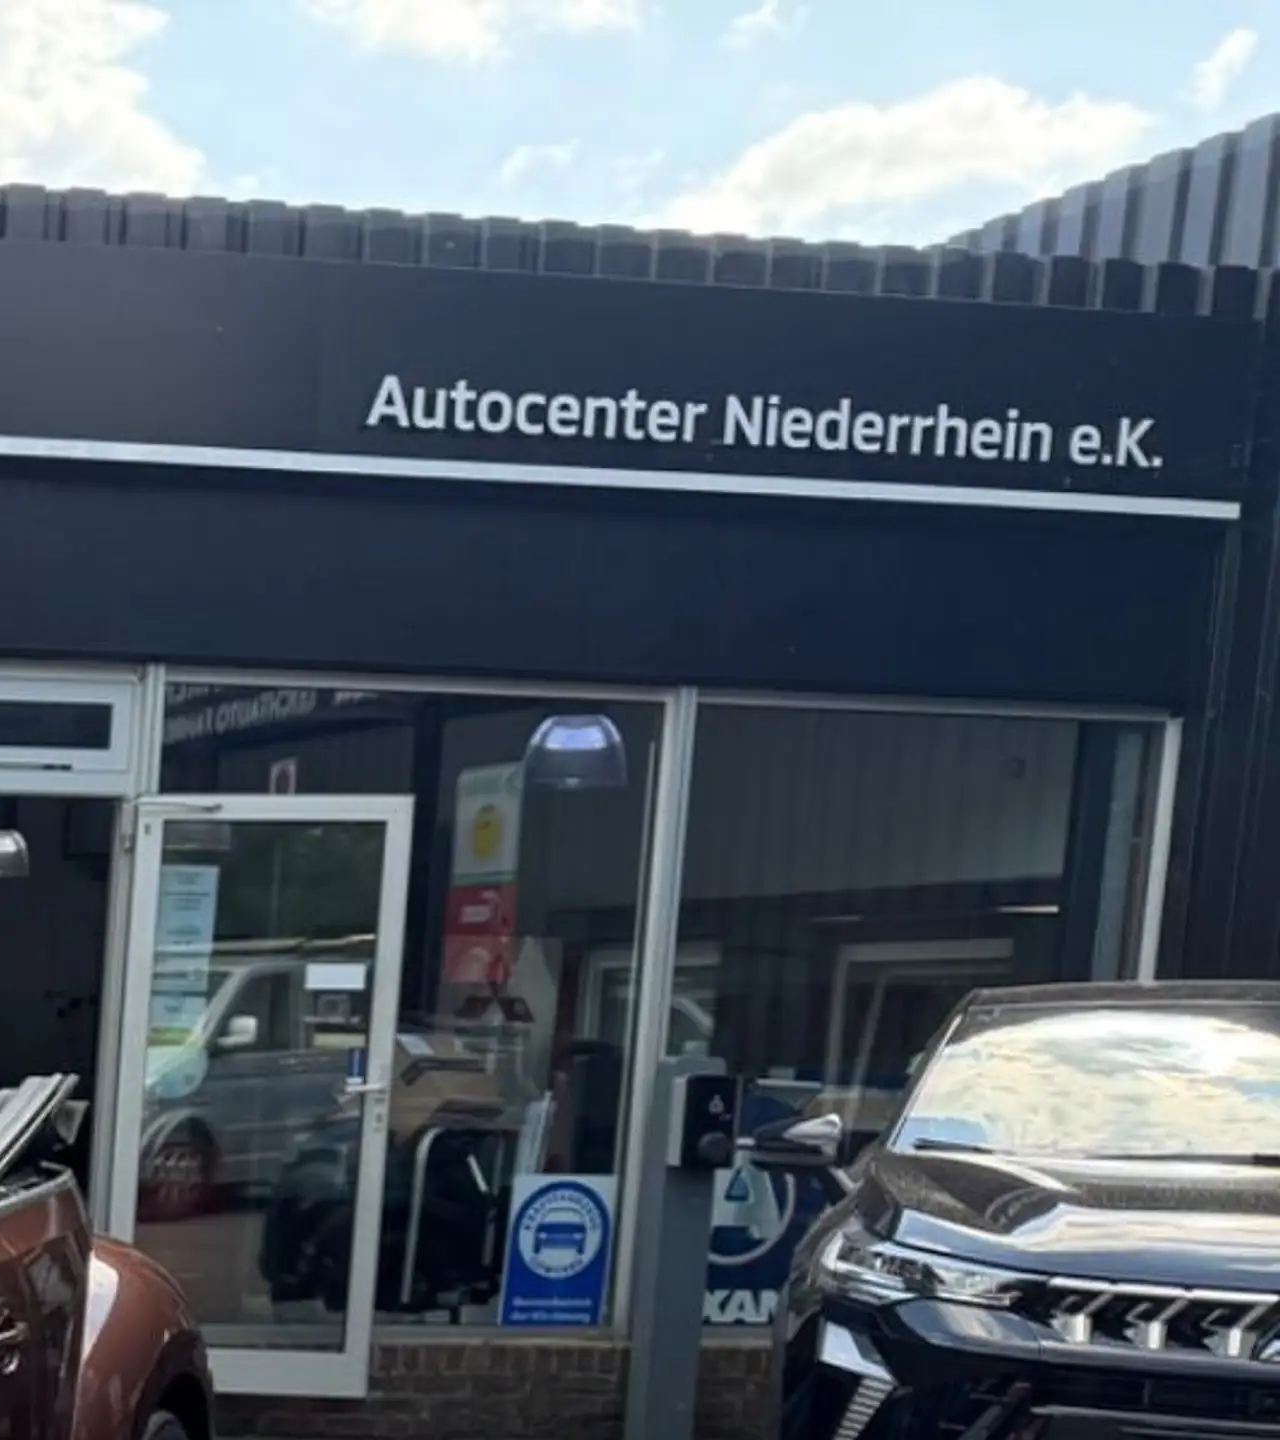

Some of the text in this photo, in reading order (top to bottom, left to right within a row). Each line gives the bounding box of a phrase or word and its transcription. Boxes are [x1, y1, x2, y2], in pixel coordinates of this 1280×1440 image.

[365, 374, 1165, 469] Autocenter Niederrhein e.K.
